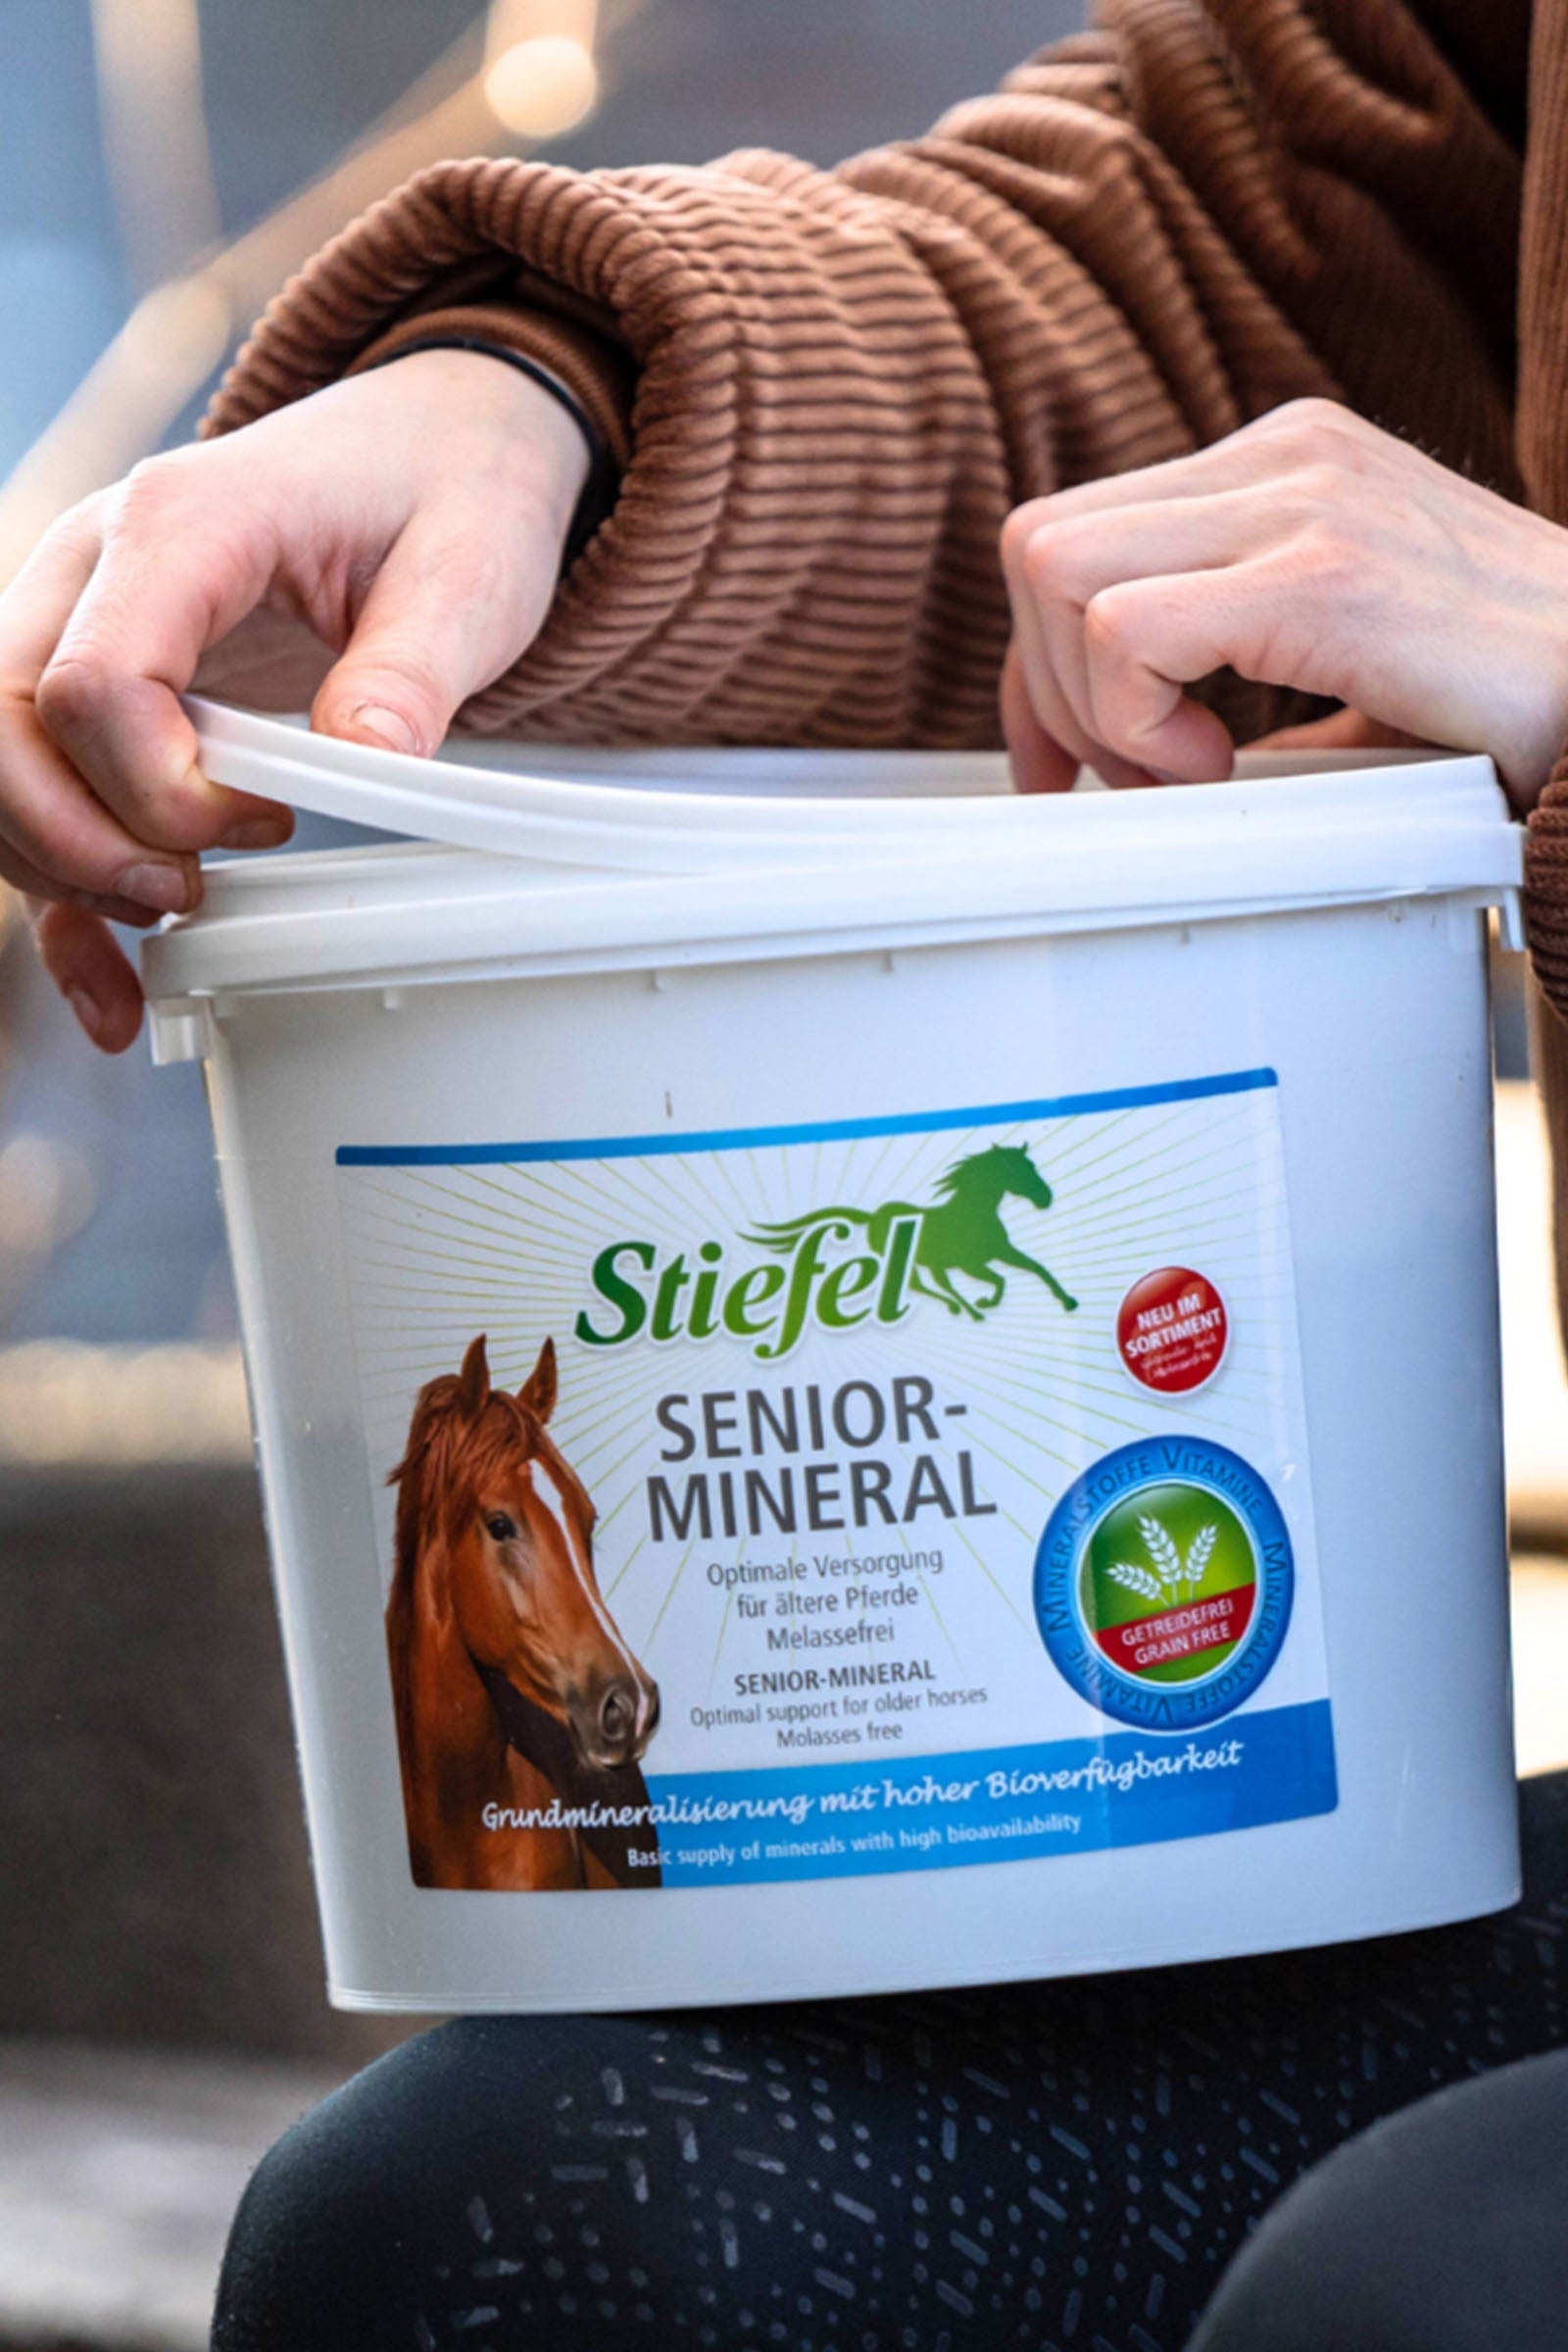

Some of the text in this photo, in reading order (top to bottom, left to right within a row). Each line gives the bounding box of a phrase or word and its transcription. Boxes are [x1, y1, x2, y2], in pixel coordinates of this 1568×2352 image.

[574, 1220, 917, 1359] Stiefel
[1137, 1293, 1200, 1330] NEU IM
[1125, 1307, 1221, 1358] SORTIMENT
[656, 1375, 967, 1462] SENIOR-
[647, 1450, 998, 1543] MINERAL
[707, 1550, 943, 1590] Optimale Versorgung
[737, 1583, 918, 1618] für ältere Pferde
[1121, 1597, 1234, 1646] GETREIDEFREI
[767, 1618, 895, 1650] Melassefrei
[1134, 1621, 1230, 1665] GRAIN FREE
[734, 1660, 936, 1695] SENIOR-MINERAL
[690, 1686, 988, 1730] Optimal support for older horses
[776, 1721, 903, 1748] Molasses free
[482, 1740, 1244, 1831] Grundmineralisierung mit hoher Bioverfügbarkeit
[628, 1813, 1080, 1867] Basic supply of minerals with high bioavailability
